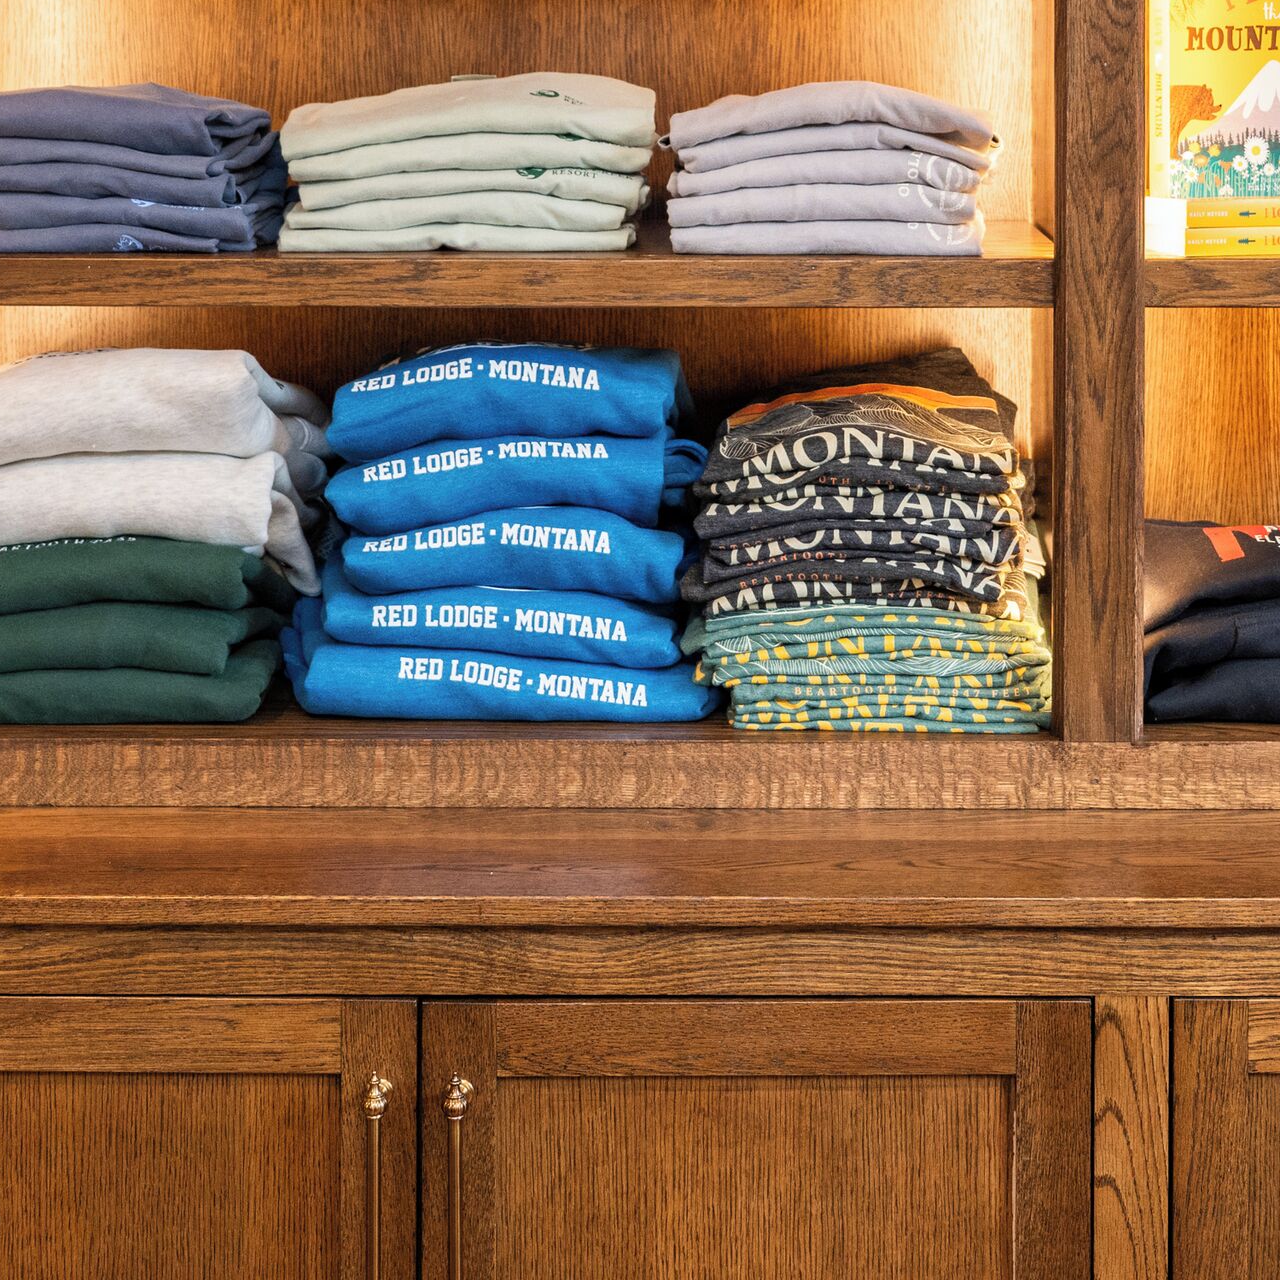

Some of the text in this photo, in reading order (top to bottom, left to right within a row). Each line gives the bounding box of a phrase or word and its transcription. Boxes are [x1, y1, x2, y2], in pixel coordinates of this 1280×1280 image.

[351, 357, 601, 393] RED LODGE MONTANA
[362, 440, 609, 483] RED LODGE MONTANA
[362, 522, 612, 554] RED LODGE MONTANA
[371, 604, 628, 643] RED LODGE MONTANA
[398, 657, 648, 708] RED LODGE MONTANA
[794, 685, 1031, 697] BEARTOOTH FEET
